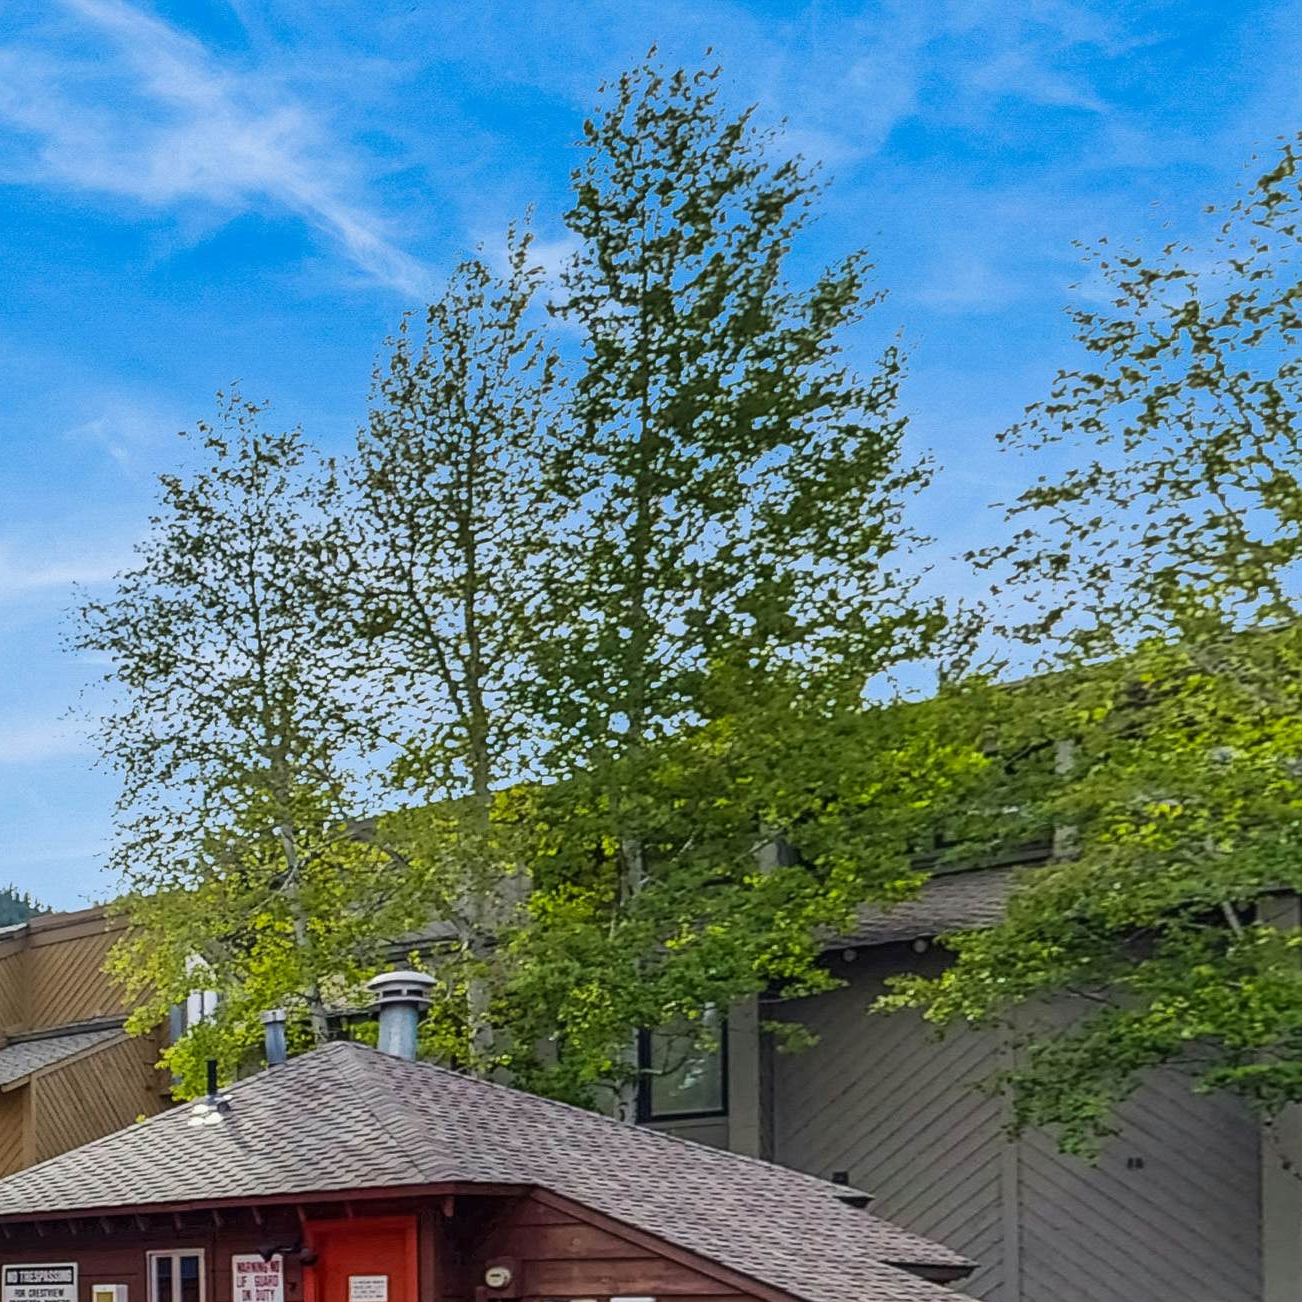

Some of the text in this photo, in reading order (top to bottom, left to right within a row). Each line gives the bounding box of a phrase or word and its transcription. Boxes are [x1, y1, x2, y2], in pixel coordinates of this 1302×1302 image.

[7, 1270, 72, 1283] NO TRESPASSING
[254, 1274, 279, 1288] GUARD
[28, 1288, 65, 1298] CRESTVIEW
[256, 1289, 275, 1302] DUTY
